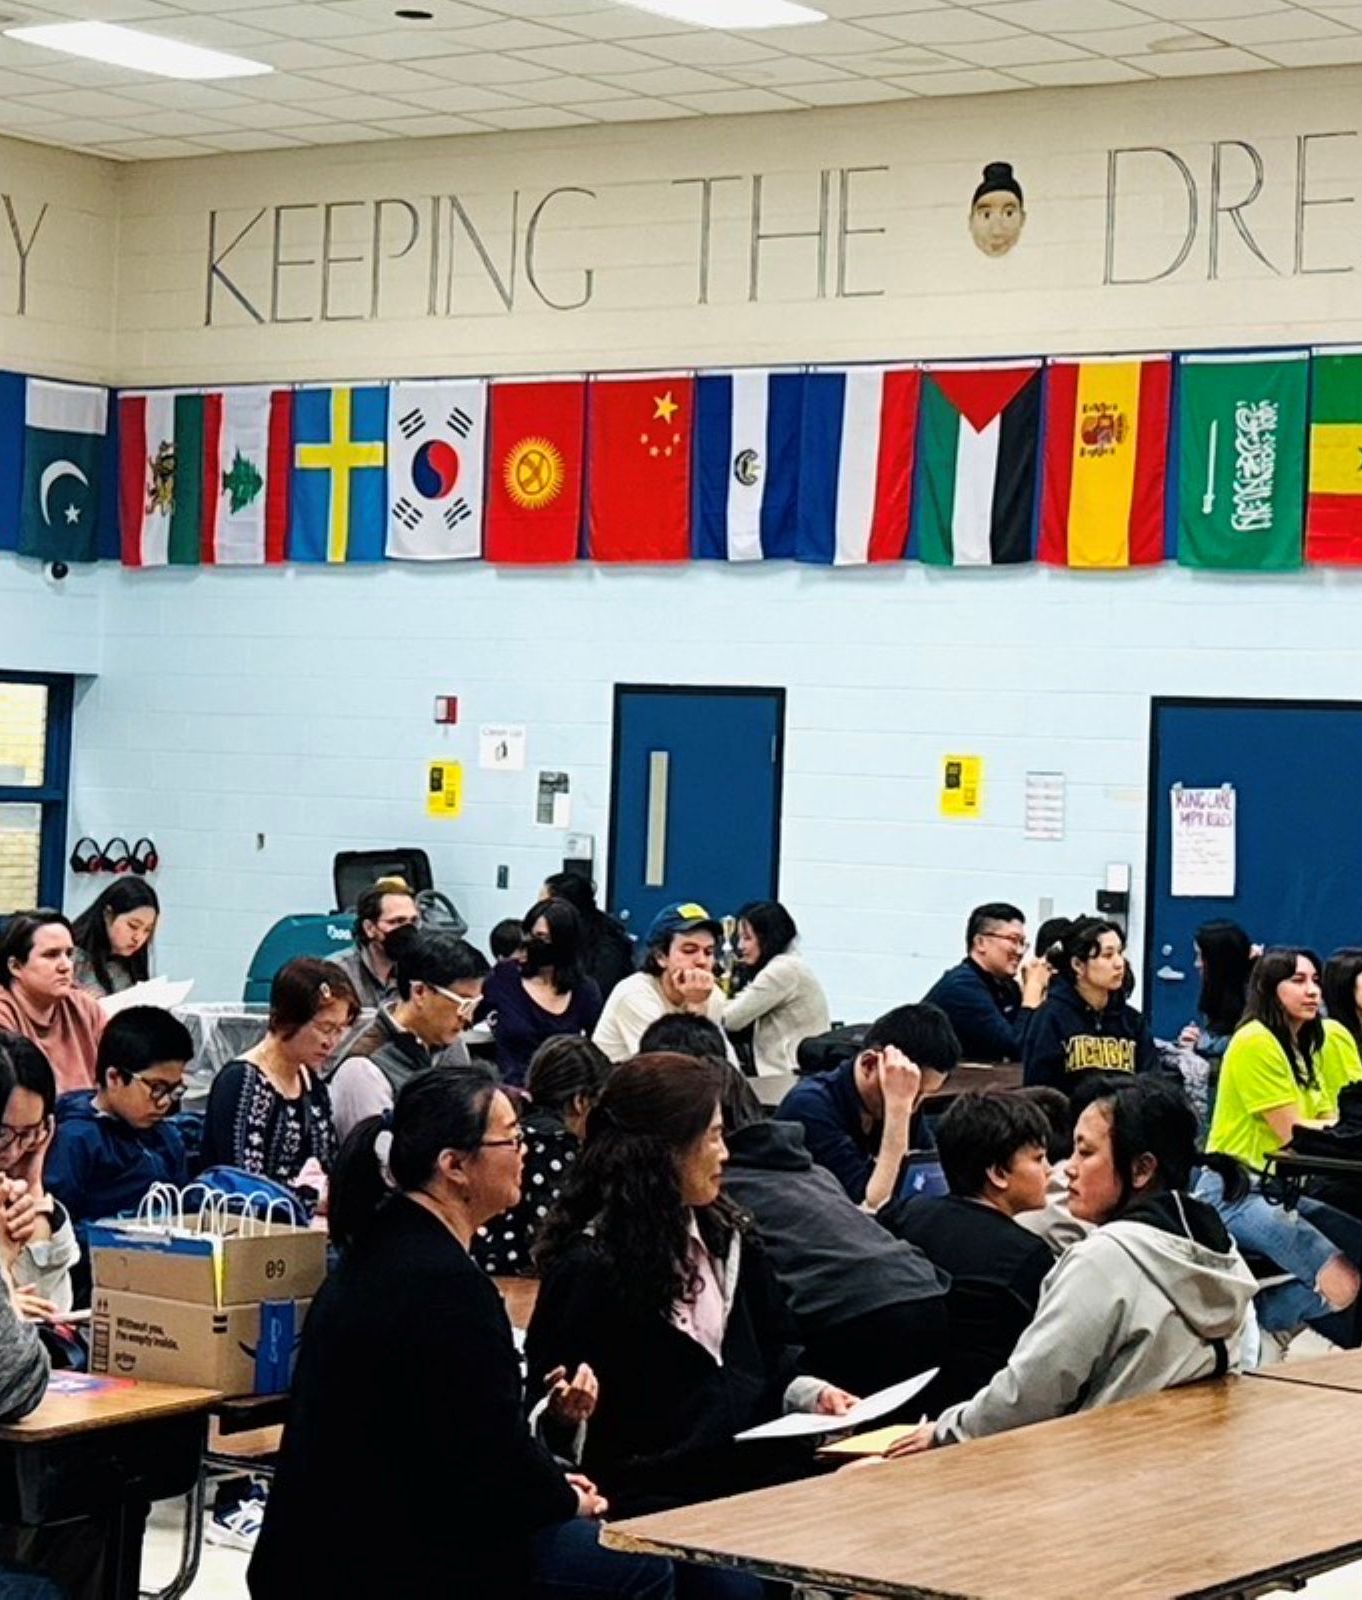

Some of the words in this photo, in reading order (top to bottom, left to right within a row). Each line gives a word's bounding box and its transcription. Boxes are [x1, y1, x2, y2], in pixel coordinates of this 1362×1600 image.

[204, 186, 597, 327] KEEPING
[672, 165, 890, 304] THE
[265, 1259, 286, 1279] 09
